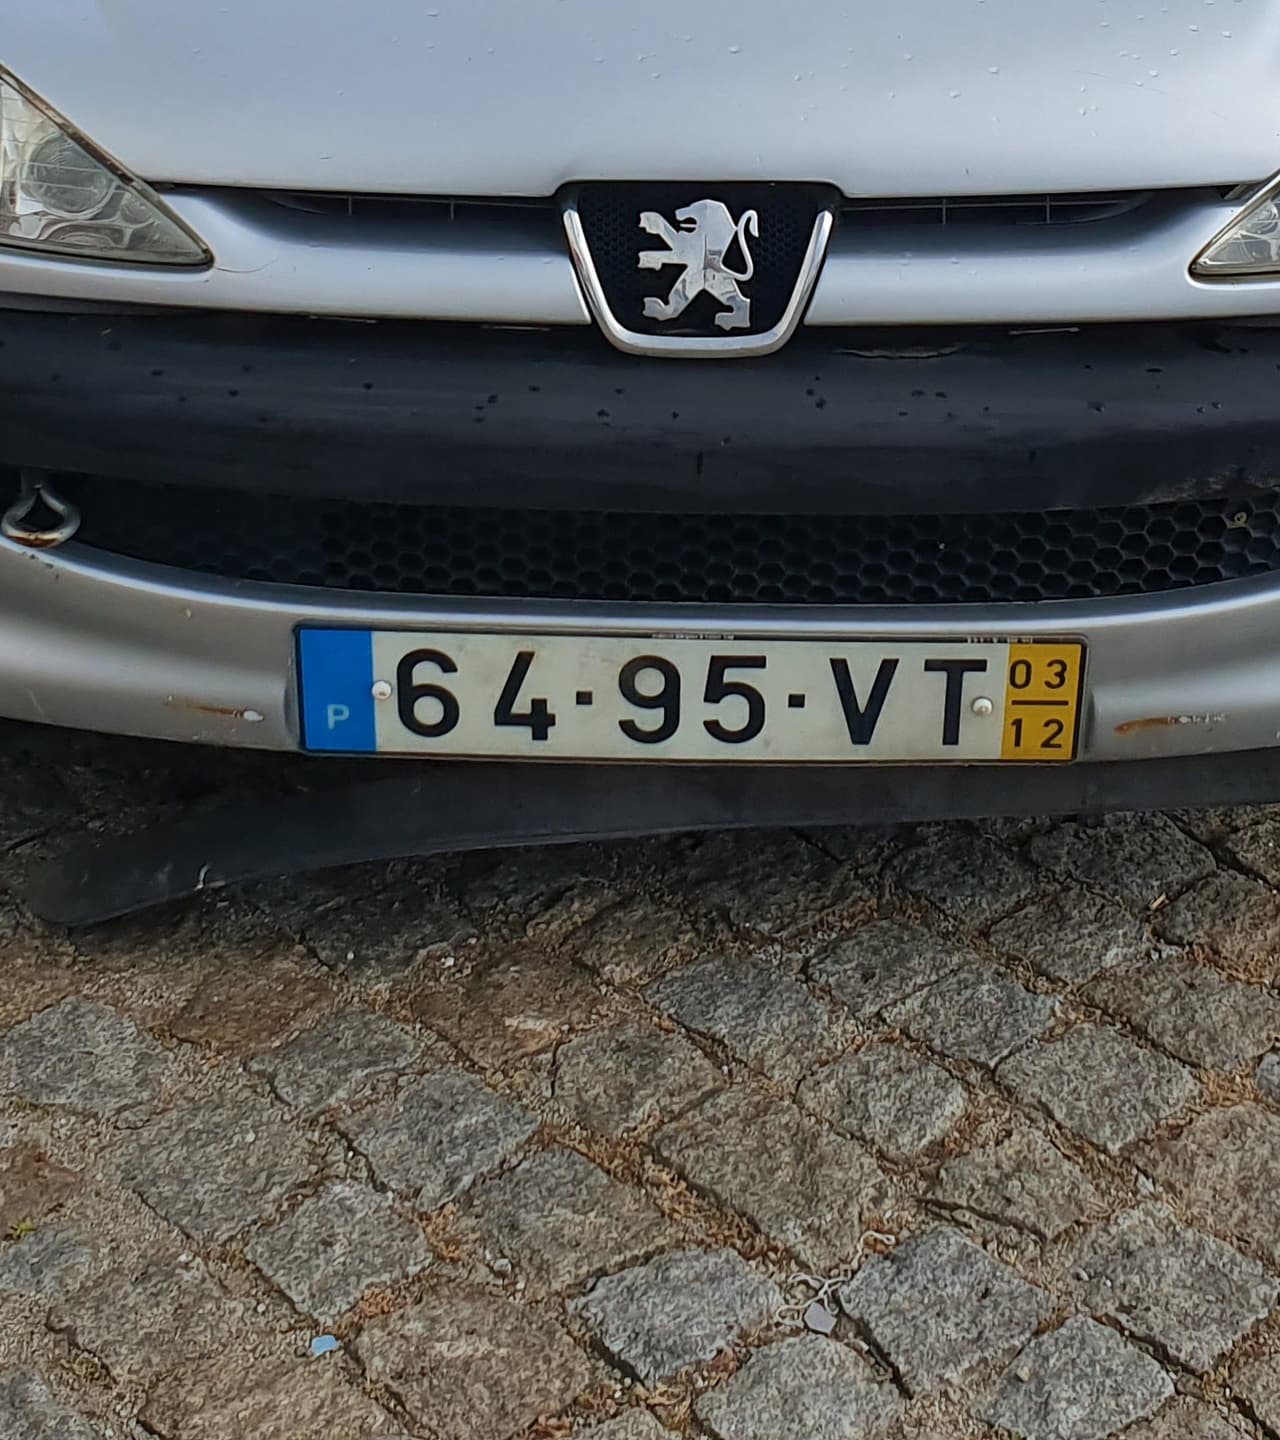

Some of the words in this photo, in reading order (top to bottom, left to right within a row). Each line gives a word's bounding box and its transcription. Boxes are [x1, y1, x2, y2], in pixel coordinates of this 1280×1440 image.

[1009, 658, 1068, 690] 03
[326, 703, 350, 729] P
[1009, 717, 1064, 749] 12
